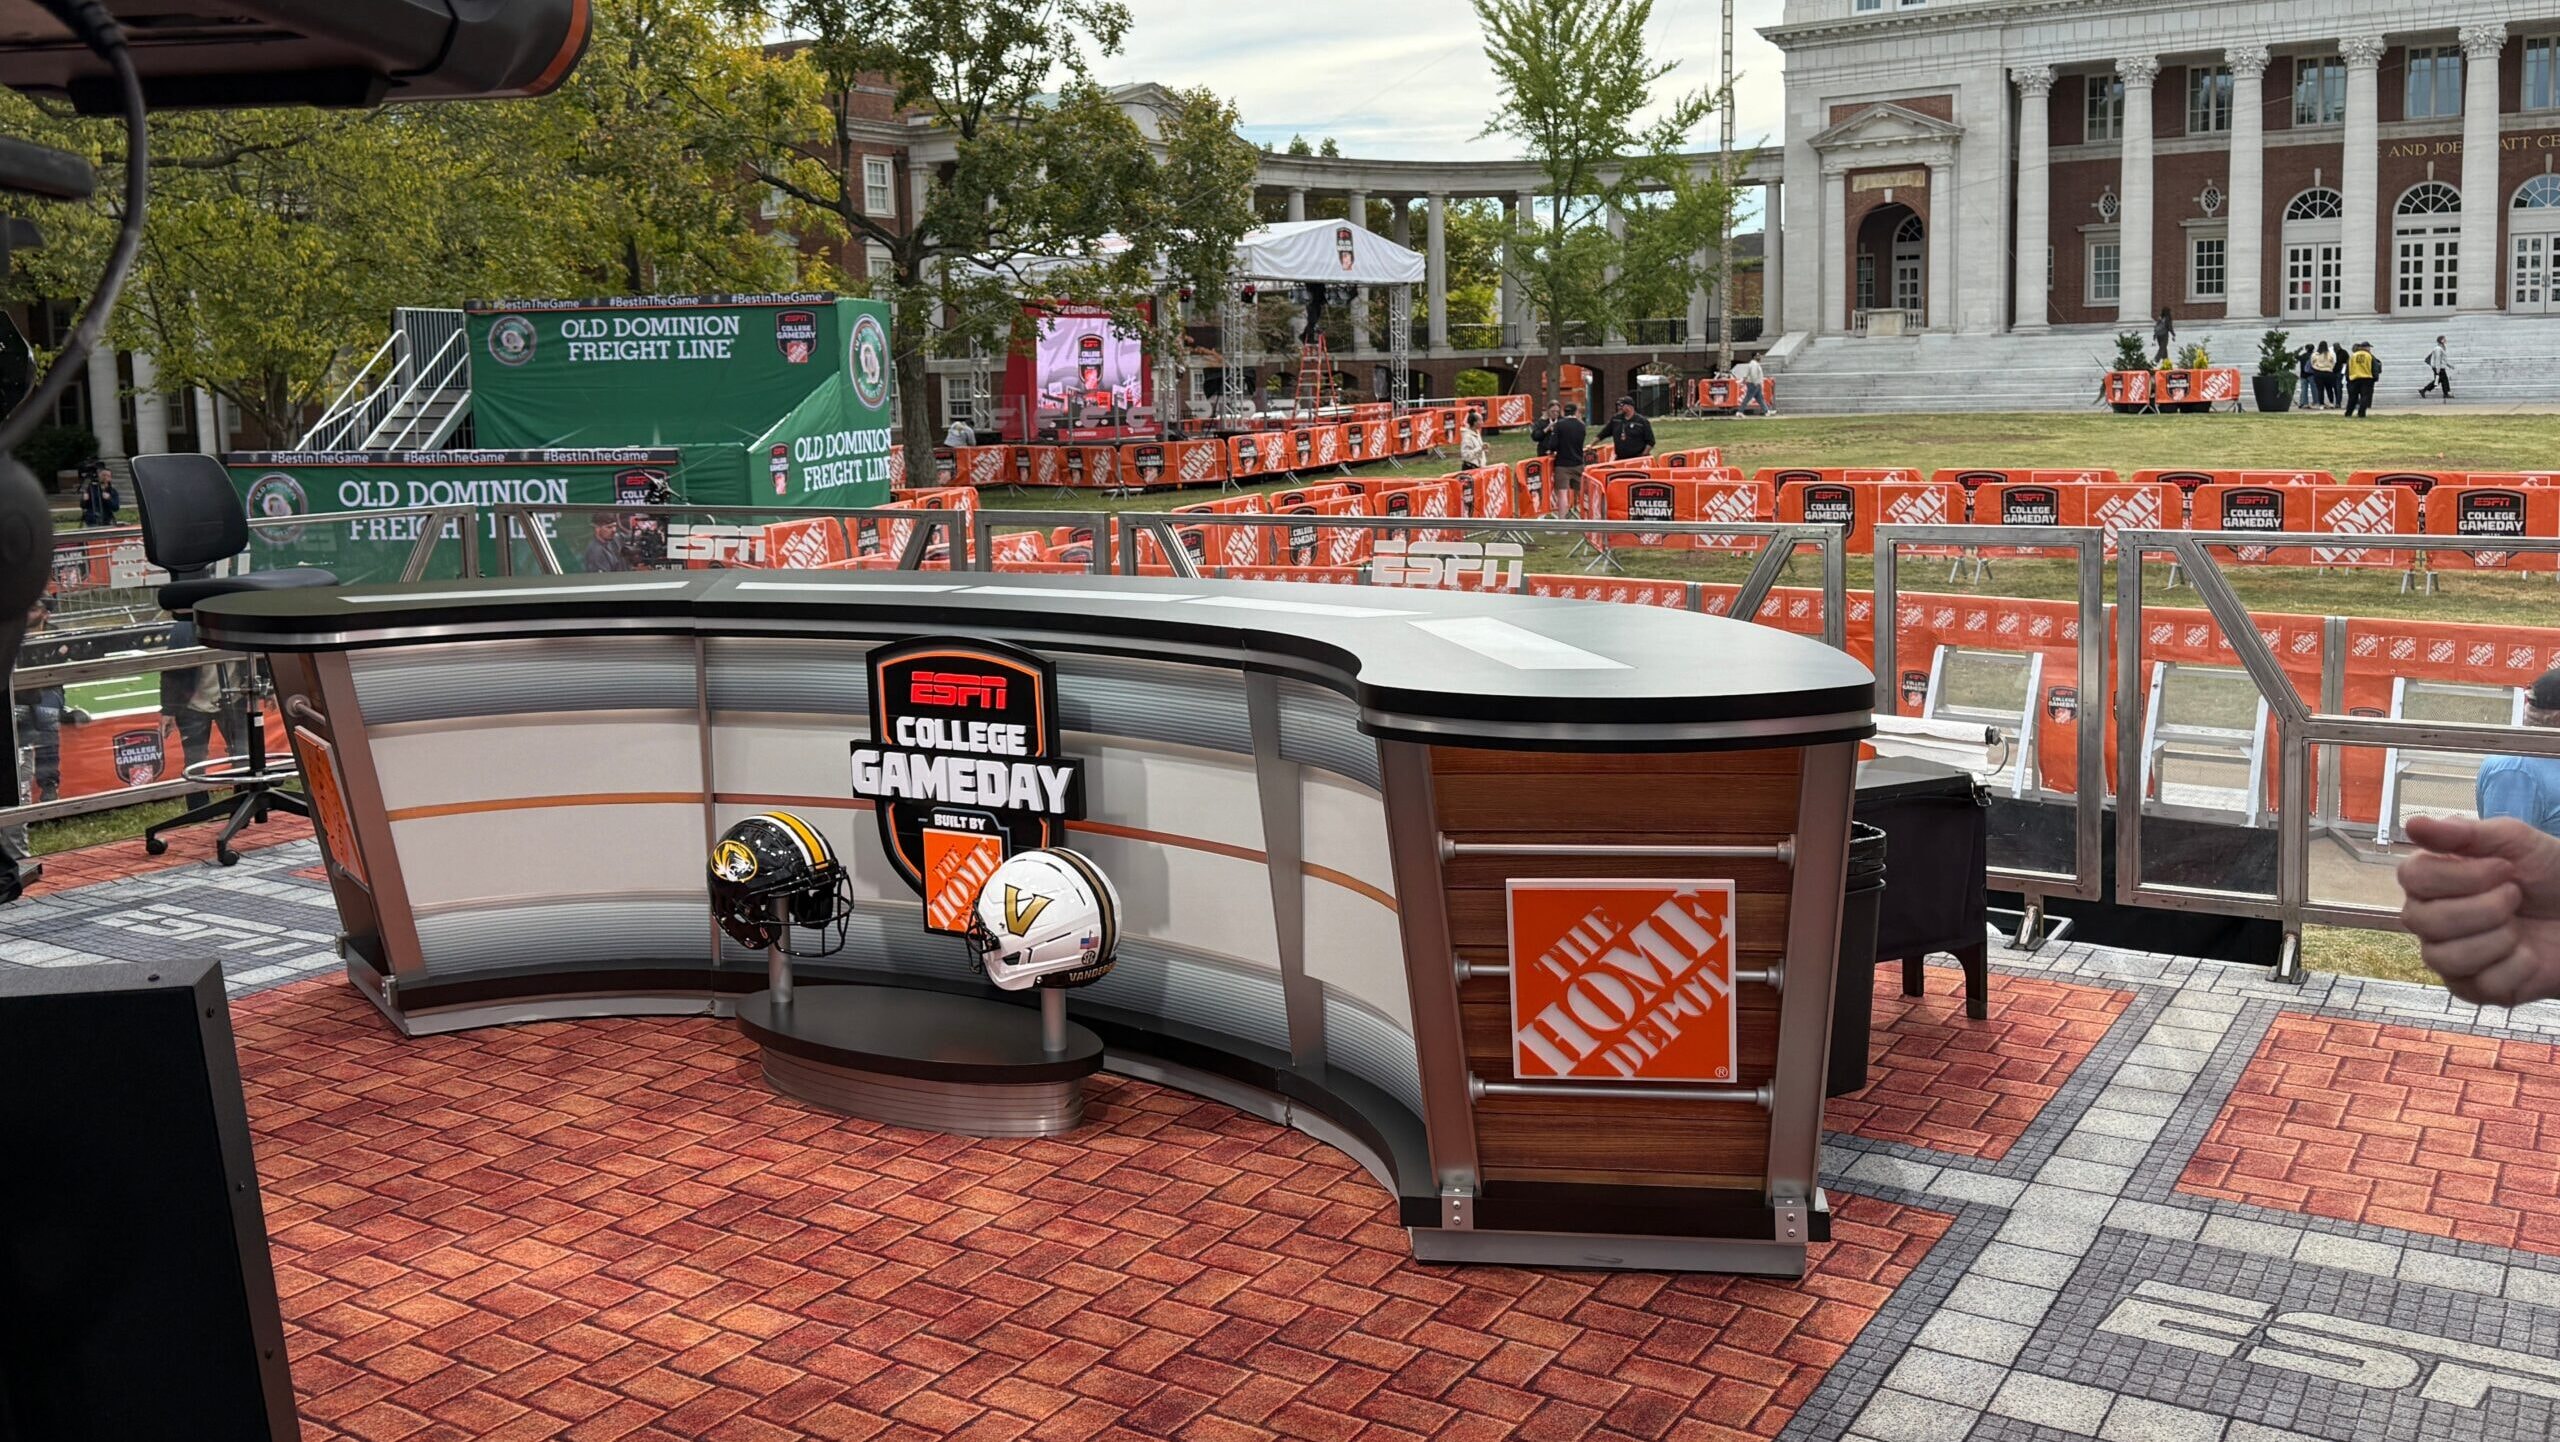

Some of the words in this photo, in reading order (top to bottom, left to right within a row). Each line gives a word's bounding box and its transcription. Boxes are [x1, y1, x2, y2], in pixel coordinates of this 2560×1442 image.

[2389, 143, 2427, 158] AND
[2433, 141, 2463, 155] JOE
[609, 295, 699, 307] #BestInTheGame
[731, 292, 823, 304] #BestInTheGame
[560, 319, 608, 339] OLD
[614, 316, 740, 338] DOMINION
[568, 341, 671, 362] FREIGHT
[677, 340, 731, 360] LINE
[271, 452, 369, 464] #BestInTheGame
[403, 452, 506, 464] #BestInTheGame
[543, 450, 648, 463] #BestInTheGame
[795, 436, 823, 463] OLD
[803, 460, 862, 492] FREIGHT
[339, 481, 399, 508] OLD
[408, 479, 568, 507] DOMINION
[1639, 488, 1663, 496] ESPN
[1815, 492, 1842, 500] ESPN
[2015, 493, 2045, 502] ESPN
[2236, 495, 2269, 504] ESPN
[2474, 497, 2511, 506] ESPN
[1629, 507, 1673, 516] GAMEDAY
[1634, 500, 1668, 508] COLLEGE
[1702, 490, 1728, 515] THE
[1811, 504, 1847, 512] COLLEGE
[1886, 493, 1914, 519] THE
[1895, 485, 1946, 524] OME
[2094, 494, 2125, 521] THE
[2321, 497, 2355, 525] THE
[1805, 511, 1853, 520] GAMEDAY
[2003, 514, 2057, 524] GAMEDAY
[2223, 518, 2282, 528] GAMEDAY
[2230, 509, 2275, 518] COLLEGE
[2467, 512, 2516, 520] COLLEGE
[350, 515, 479, 541] FREIH
[2458, 520, 2524, 531] GAMEDAY
[667, 524, 765, 562] ESPN
[1371, 540, 1524, 588] ESPN
[910, 671, 1008, 710] ESPN
[896, 716, 1028, 756] COLLEGE
[116, 752, 162, 765] GAMEDAY
[121, 746, 156, 756] COLLEGE
[851, 749, 1074, 814] GAMEDAY
[934, 814, 967, 829] BUILT
[969, 816, 986, 831] BY
[932, 845, 962, 881] THE
[928, 837, 1002, 931] HOME
[1004, 883, 1055, 938] V
[1532, 905, 1624, 983] THE
[1517, 887, 1730, 1077] HOME
[1601, 959, 1730, 1077] DEPOT
[2097, 1279, 2560, 1409] ESP
